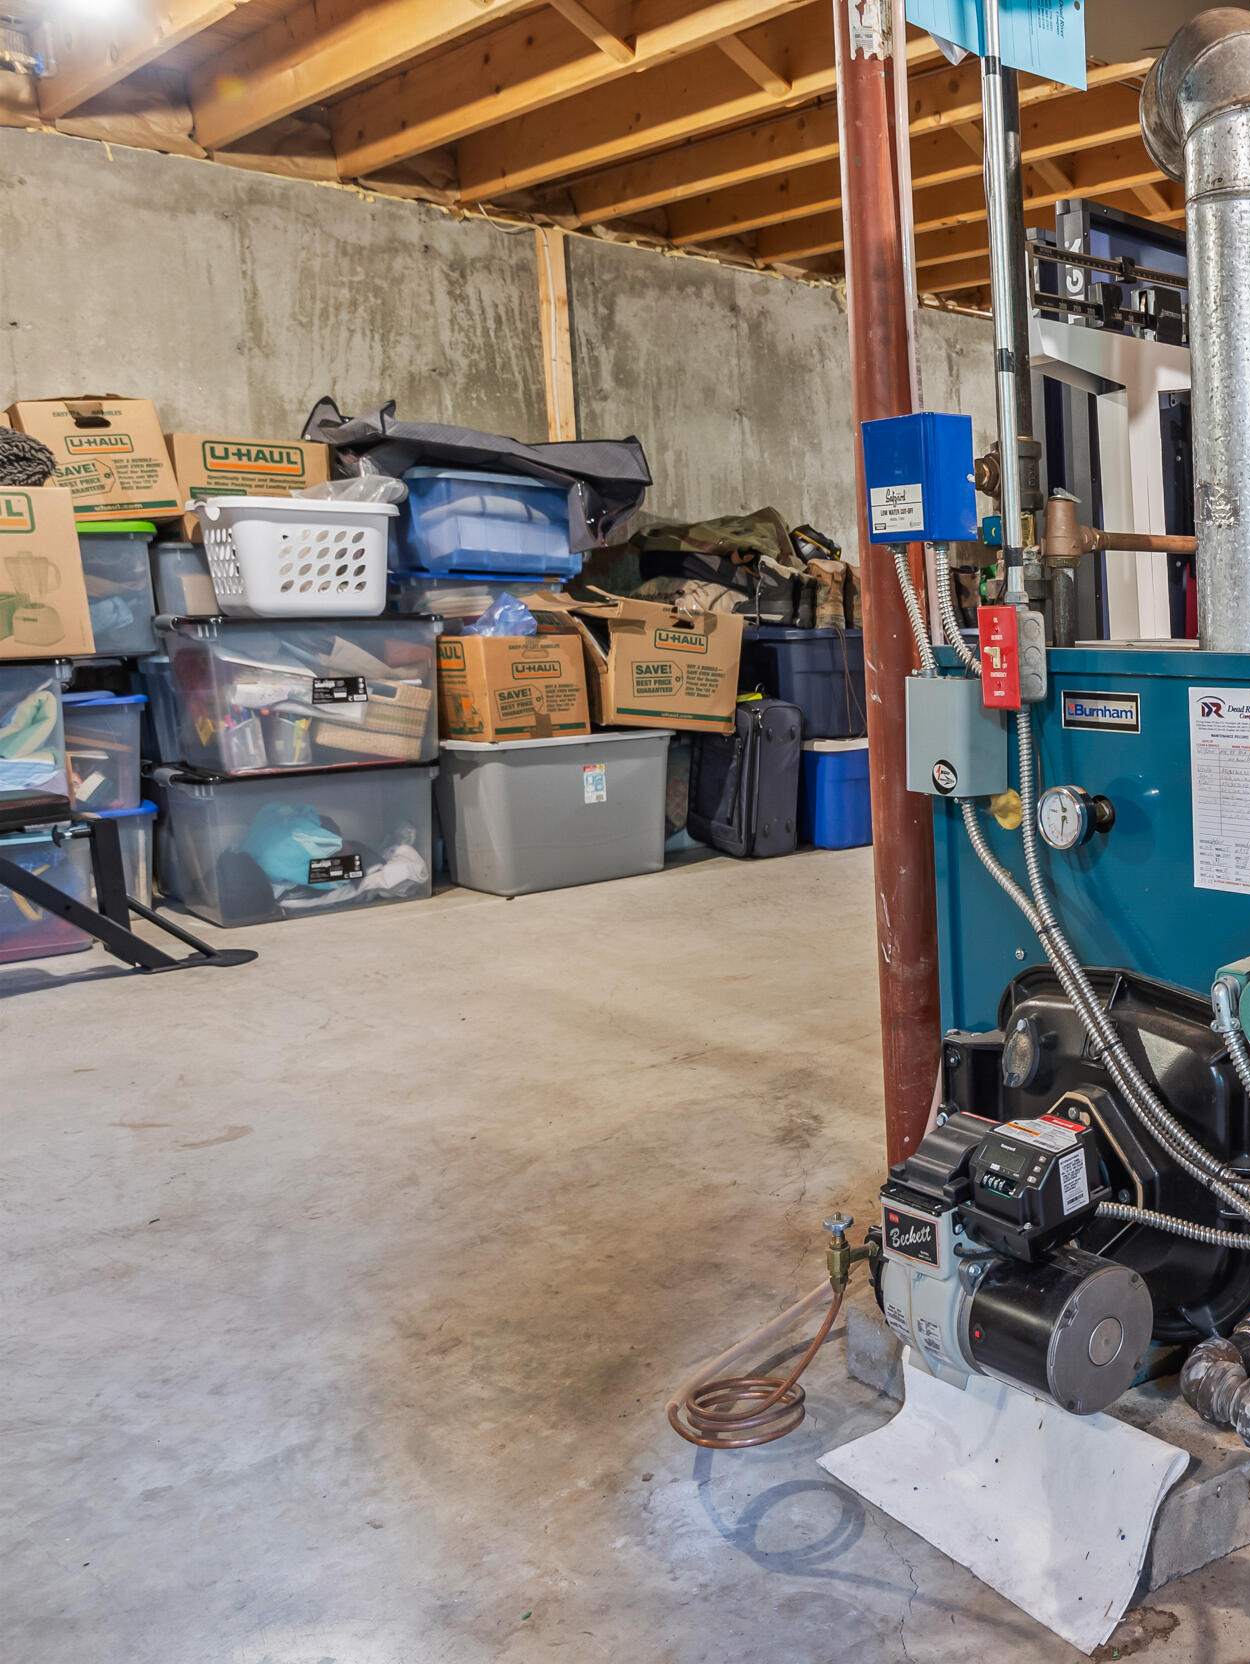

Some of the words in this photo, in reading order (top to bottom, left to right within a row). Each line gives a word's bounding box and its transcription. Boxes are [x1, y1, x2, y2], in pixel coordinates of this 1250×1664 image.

[69, 437, 129, 448] U-HAUL
[209, 446, 298, 465] U-HAUL
[54, 463, 98, 478] SAVE!
[80, 477, 102, 486] PRICE
[658, 632, 704, 646] U-HAUL
[515, 664, 558, 673] U-HAUL
[636, 665, 672, 675] SAVE!
[498, 688, 532, 701] SAVE!
[517, 701, 533, 709] PRICE
[1074, 703, 1134, 719] Burnham
[1227, 705, 1244, 713] Dead
[890, 1225, 931, 1247] Beckett
